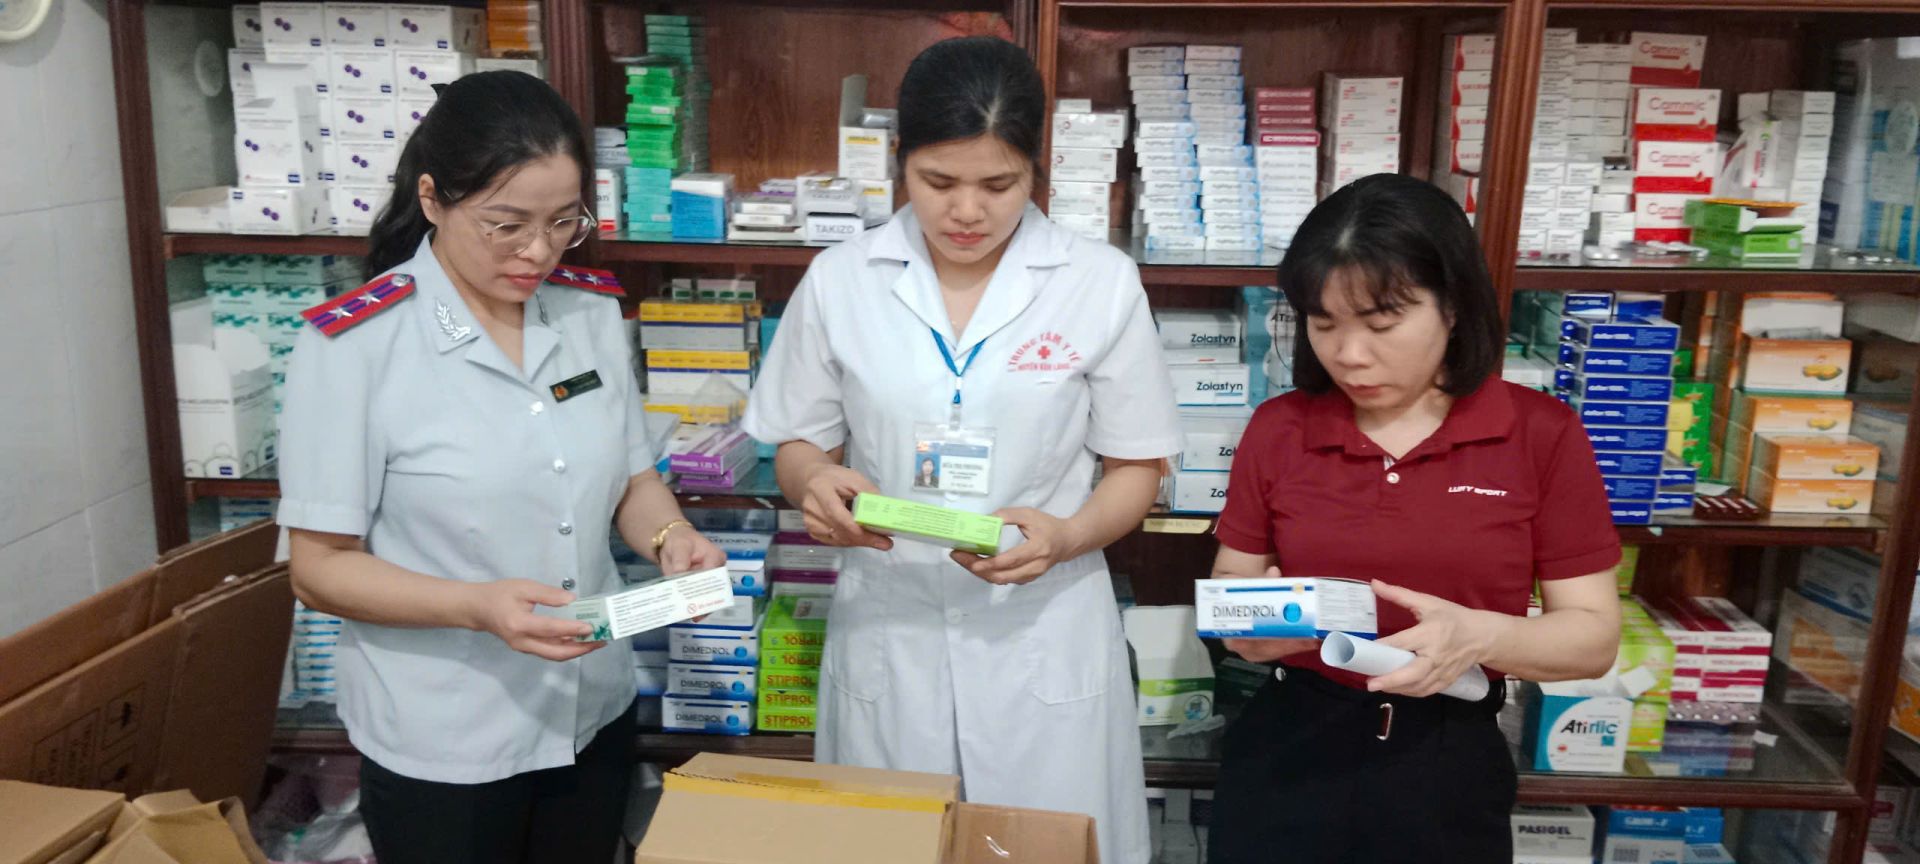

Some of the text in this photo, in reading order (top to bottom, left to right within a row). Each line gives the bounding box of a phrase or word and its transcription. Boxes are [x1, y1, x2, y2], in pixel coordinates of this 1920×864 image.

[1639, 40, 1690, 56] Cammic
[1649, 96, 1706, 111] Cammic
[1648, 150, 1701, 163] Cammic
[1190, 333, 1236, 344] Zolastyn
[1008, 338, 1037, 365] TRUNG
[1062, 342, 1071, 351] Y
[1196, 380, 1243, 394] Zolastyn
[1212, 605, 1276, 618] DIMEDROL
[682, 645, 730, 656] DIMEDROL
[680, 679, 728, 690] DIMEDROL
[767, 675, 816, 687] STIPROL
[766, 693, 813, 704] STIPROL
[674, 712, 722, 724] DIMEDROL
[764, 715, 813, 727] STIPROL
[1560, 719, 1618, 734] Atirlic
[1517, 825, 1572, 836] PASIGEL
